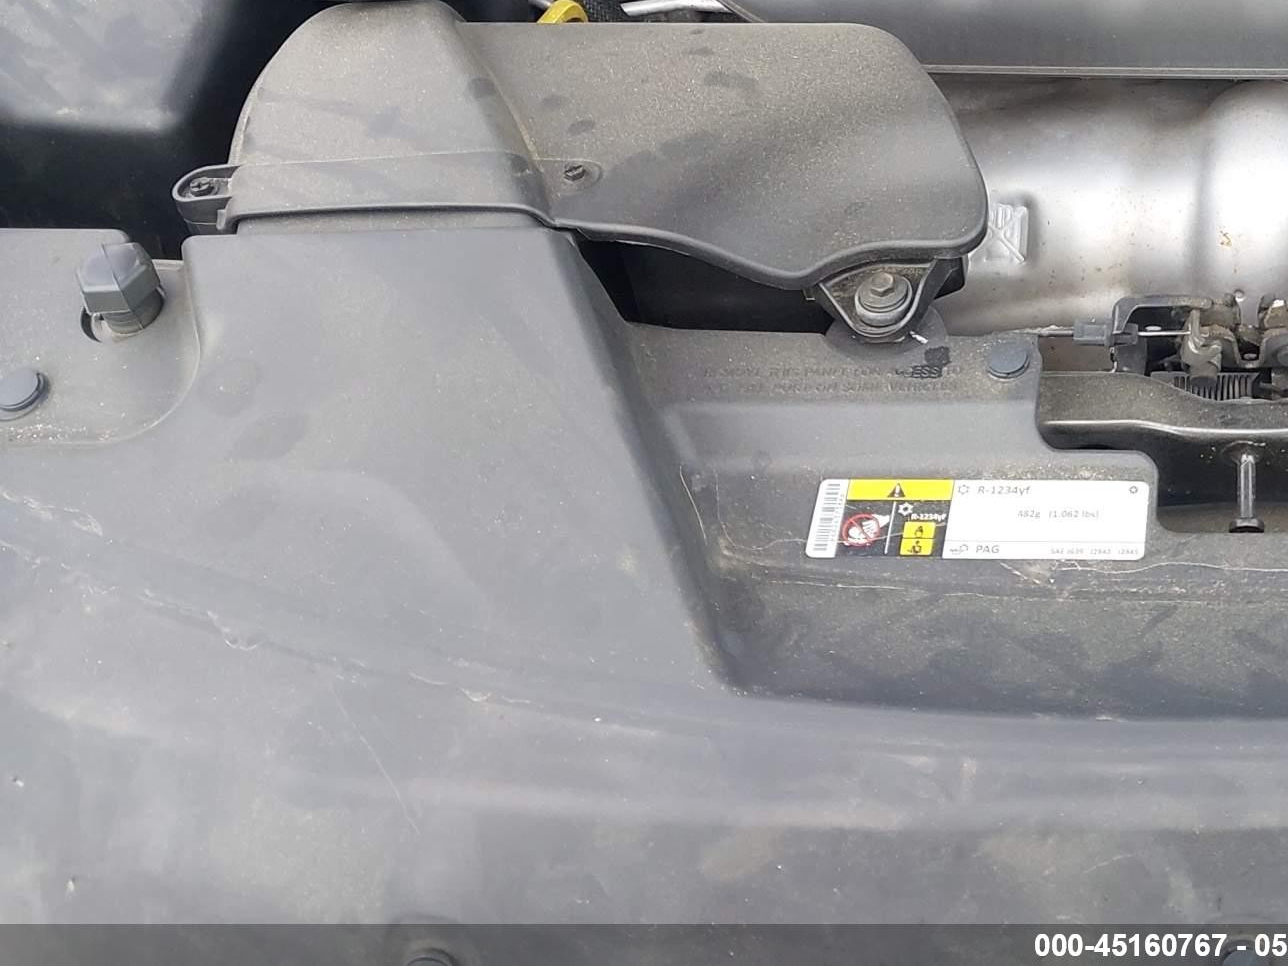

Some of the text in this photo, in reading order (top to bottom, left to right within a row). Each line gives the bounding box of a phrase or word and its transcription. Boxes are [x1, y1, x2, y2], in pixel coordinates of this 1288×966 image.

[977, 485, 1031, 496] R-1234yf
[911, 513, 947, 522] R-1234yf
[975, 544, 1000, 554] PAG
